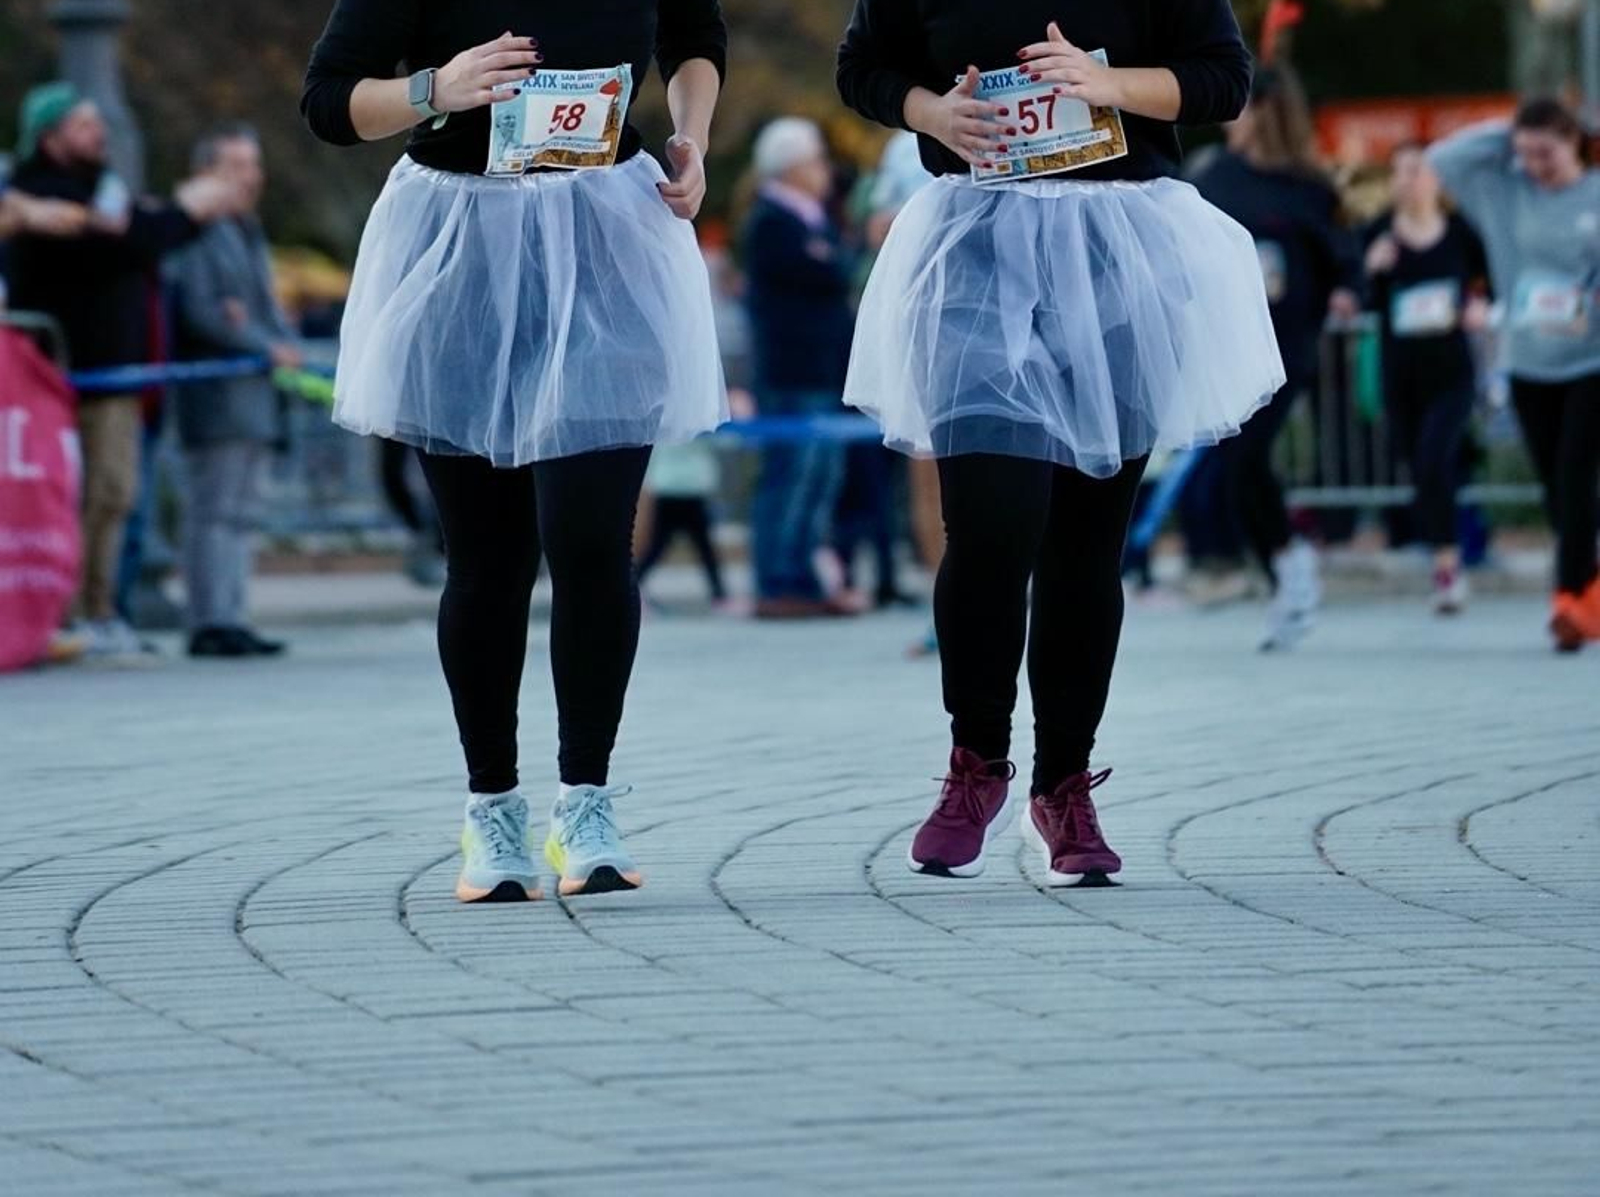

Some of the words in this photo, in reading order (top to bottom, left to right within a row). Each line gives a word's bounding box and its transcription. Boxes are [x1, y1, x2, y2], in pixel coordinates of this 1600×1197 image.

[981, 73, 1014, 90] XXIX
[549, 103, 586, 134] 58
[1018, 94, 1056, 135] 57
